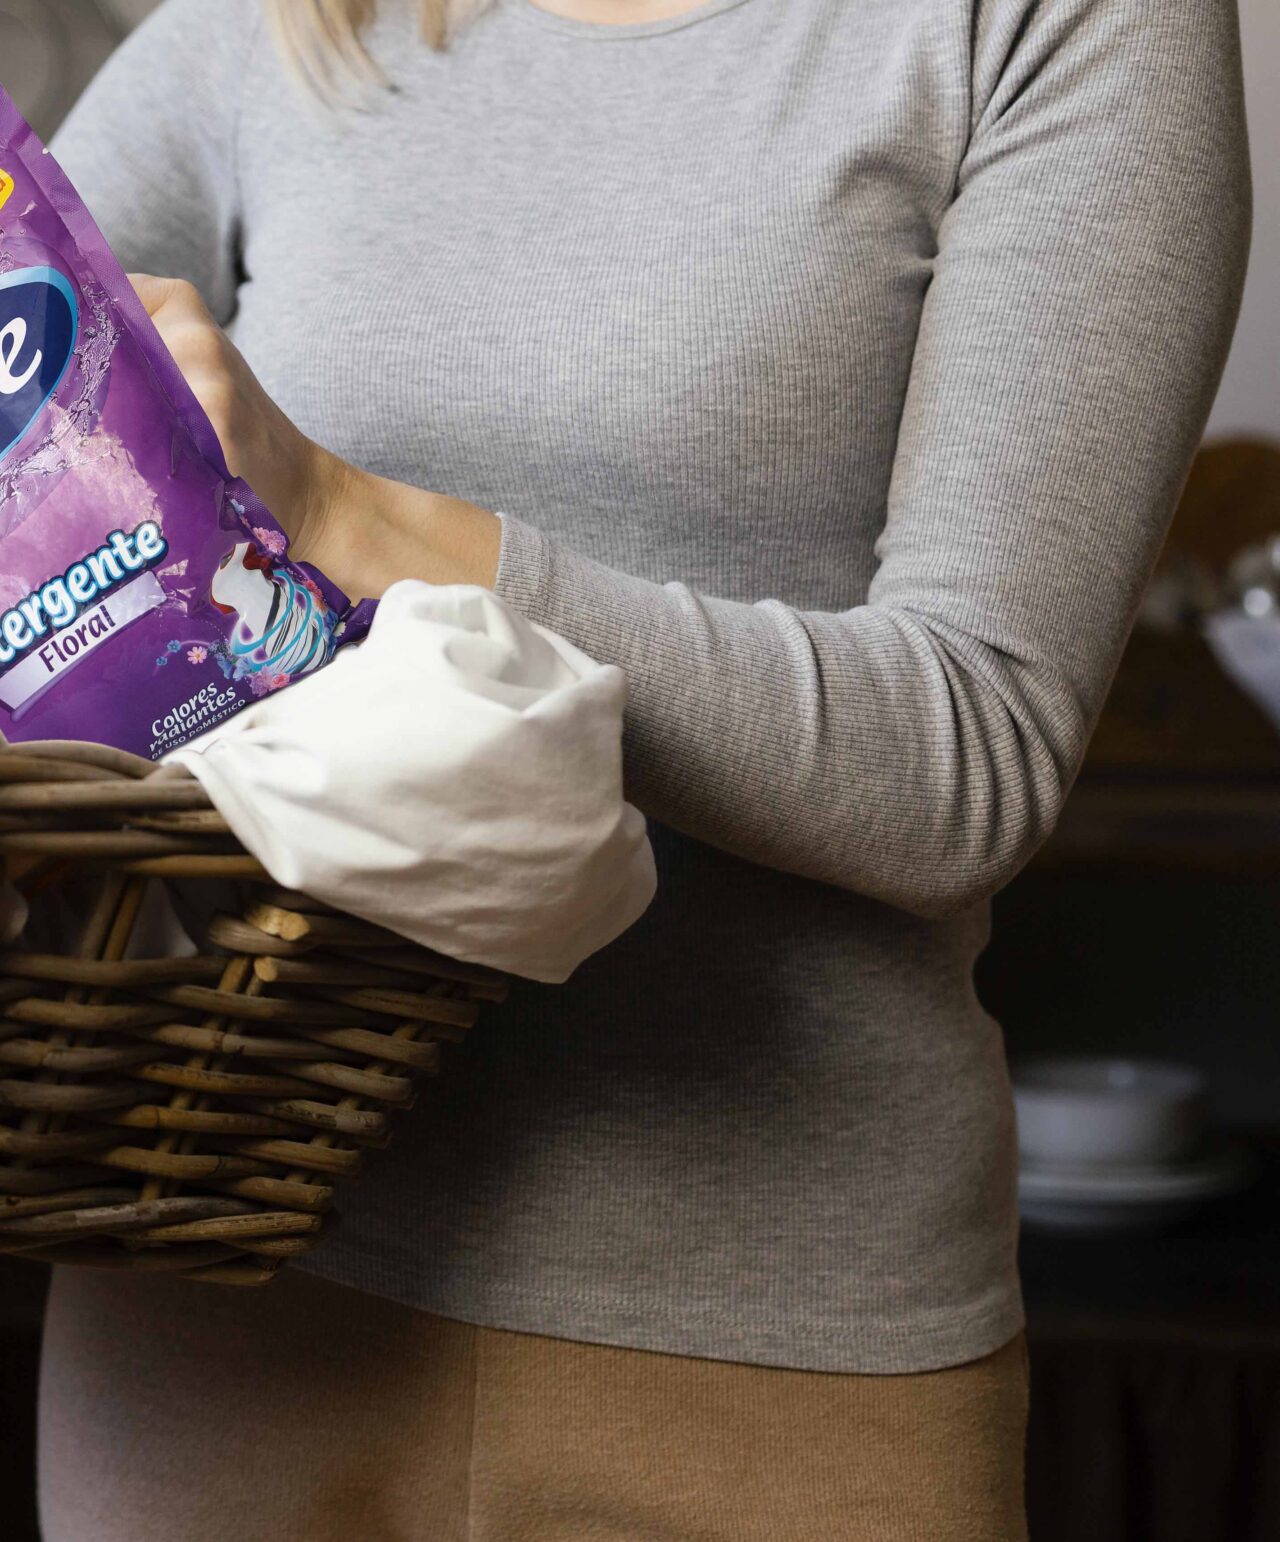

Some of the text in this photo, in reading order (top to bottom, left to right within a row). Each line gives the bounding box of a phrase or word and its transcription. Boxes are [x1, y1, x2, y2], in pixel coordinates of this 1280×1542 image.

[38, 603, 116, 673] Floral
[149, 686, 237, 752] radiantes
[151, 682, 218, 737] Colores
[165, 735, 186, 749] USO
[188, 698, 246, 737] DOMÉSTICO
